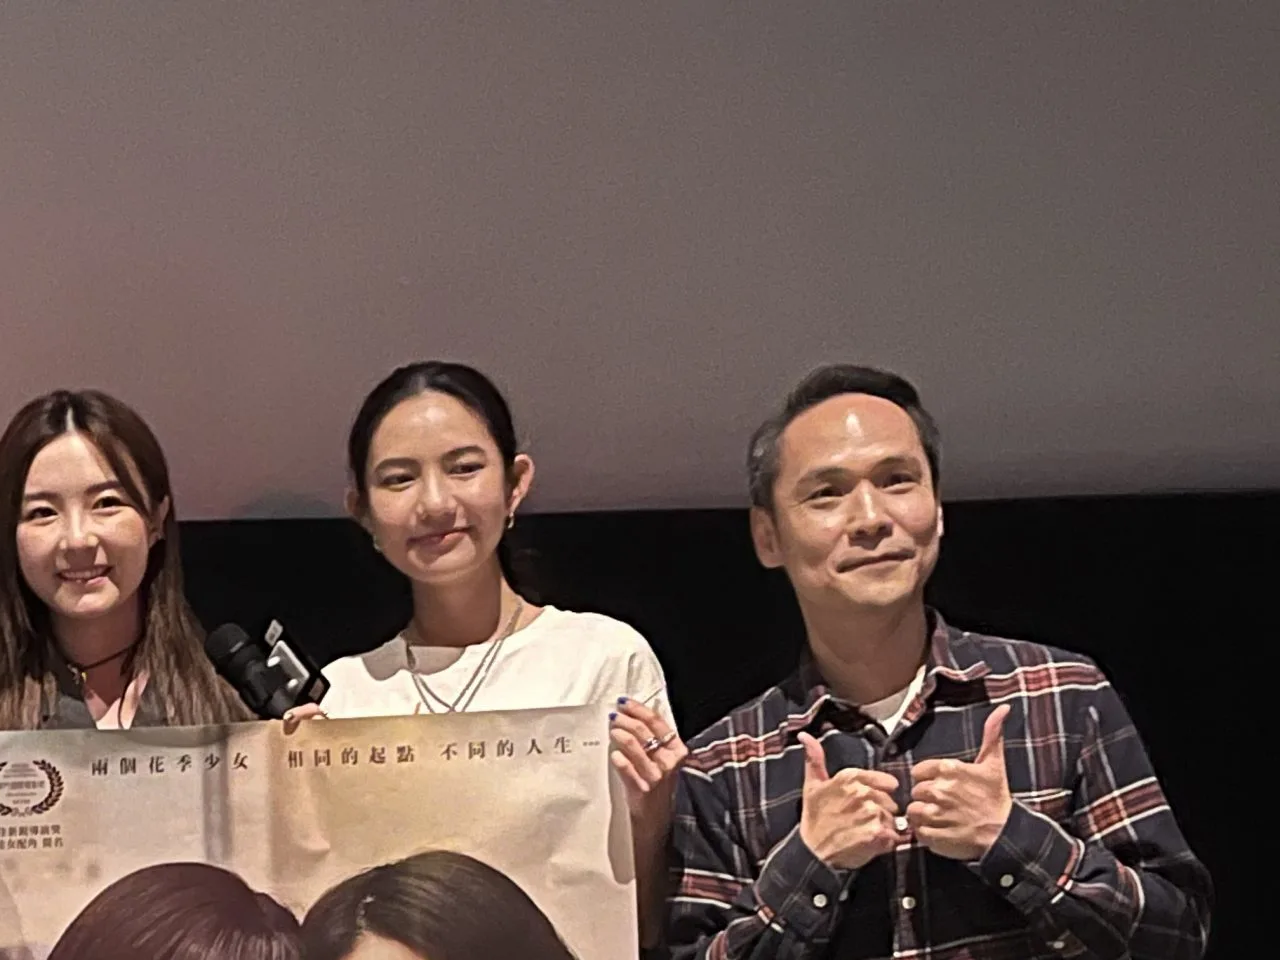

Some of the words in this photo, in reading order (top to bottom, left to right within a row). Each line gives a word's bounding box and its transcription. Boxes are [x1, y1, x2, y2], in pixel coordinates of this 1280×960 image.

[91, 752, 249, 776] 兩個花季少女
[288, 744, 416, 769] 相同的起點
